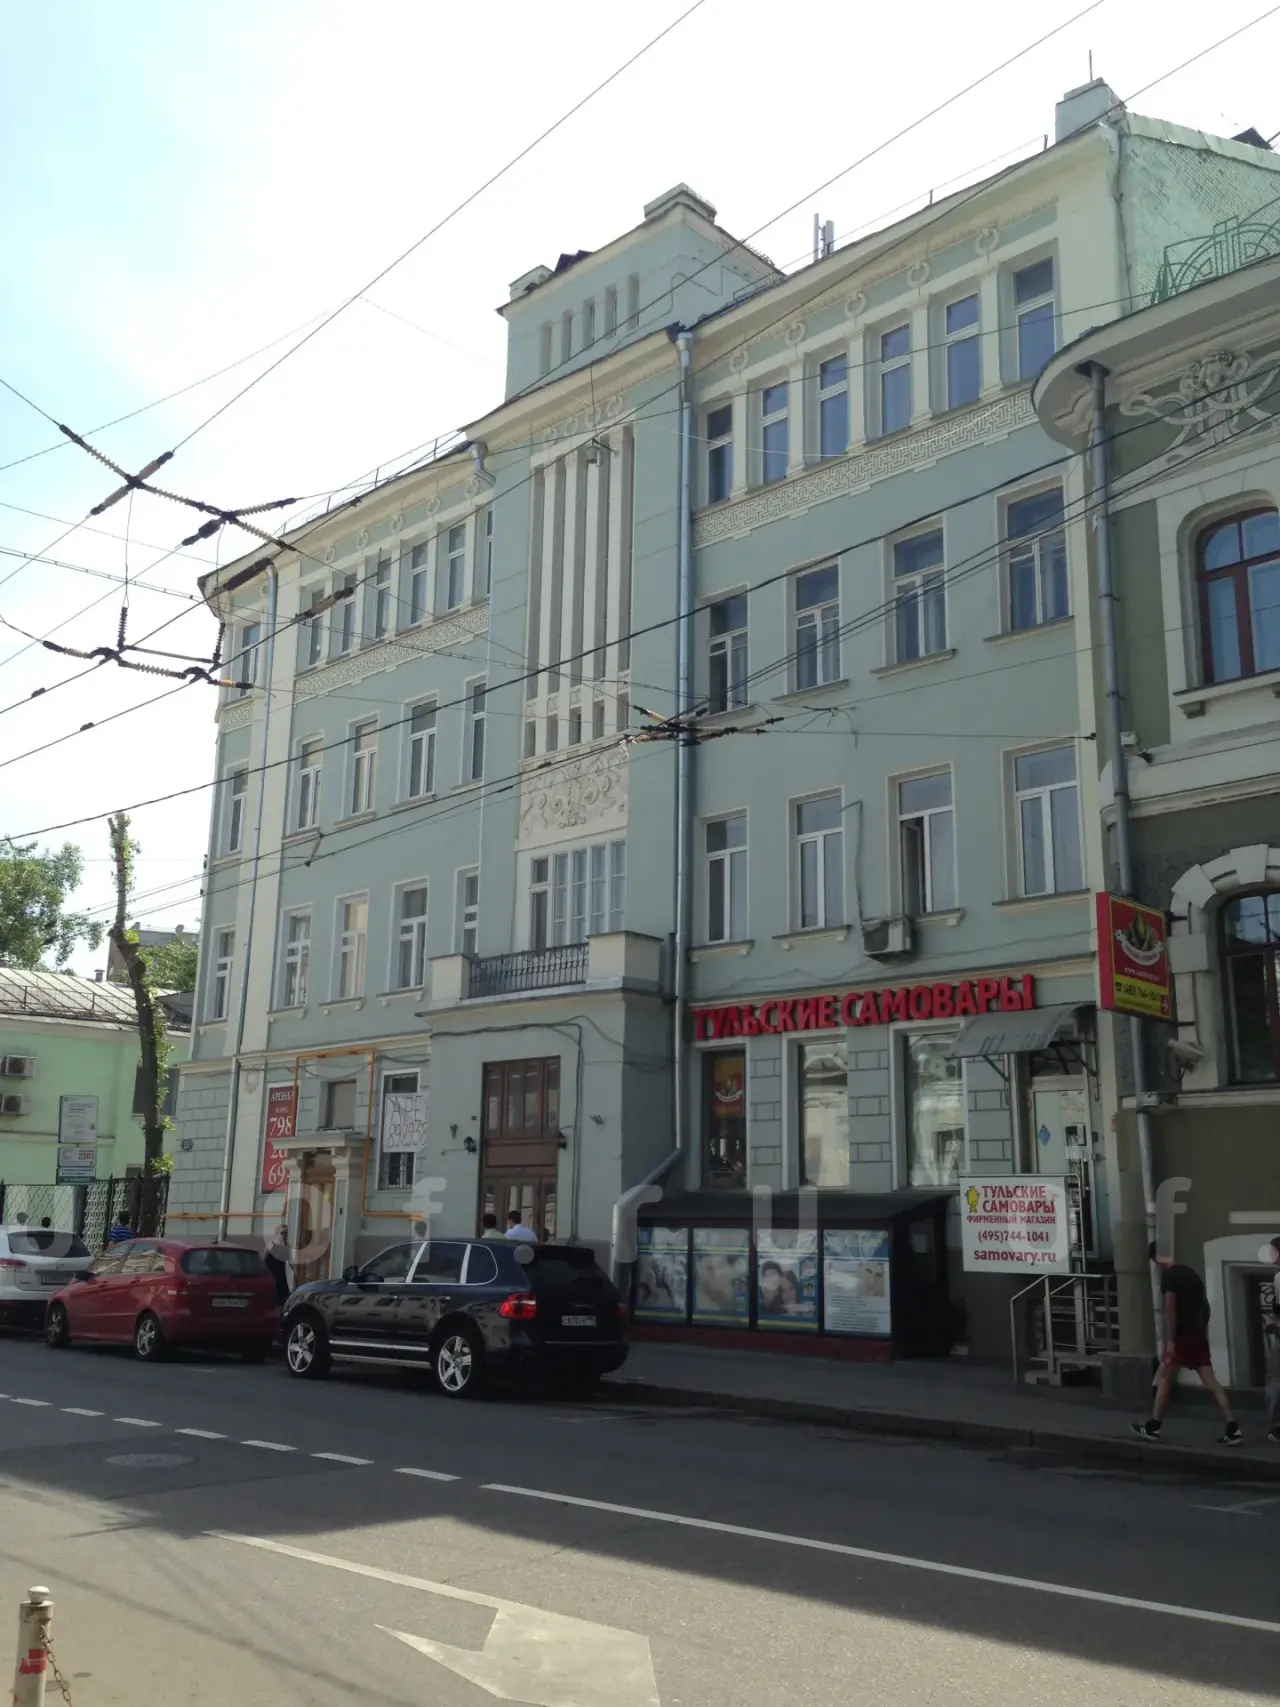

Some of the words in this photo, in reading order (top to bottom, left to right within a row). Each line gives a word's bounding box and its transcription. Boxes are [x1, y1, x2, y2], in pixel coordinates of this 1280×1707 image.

[692, 996, 838, 1040] ТУЛЬСКИЕ
[840, 974, 1036, 1026] САМОВАРЫ
[981, 1185, 1046, 1199] ТУЛЬСКИЕ
[982, 1199, 1055, 1214] САМОВАРЫ
[966, 1215, 1017, 1224] ФИРМЕННЫЙ
[1019, 1215, 1055, 1224] МАГАЗИН
[978, 1230, 1049, 1243] (495)744-1041
[973, 1249, 1057, 1265] samovary.ru
